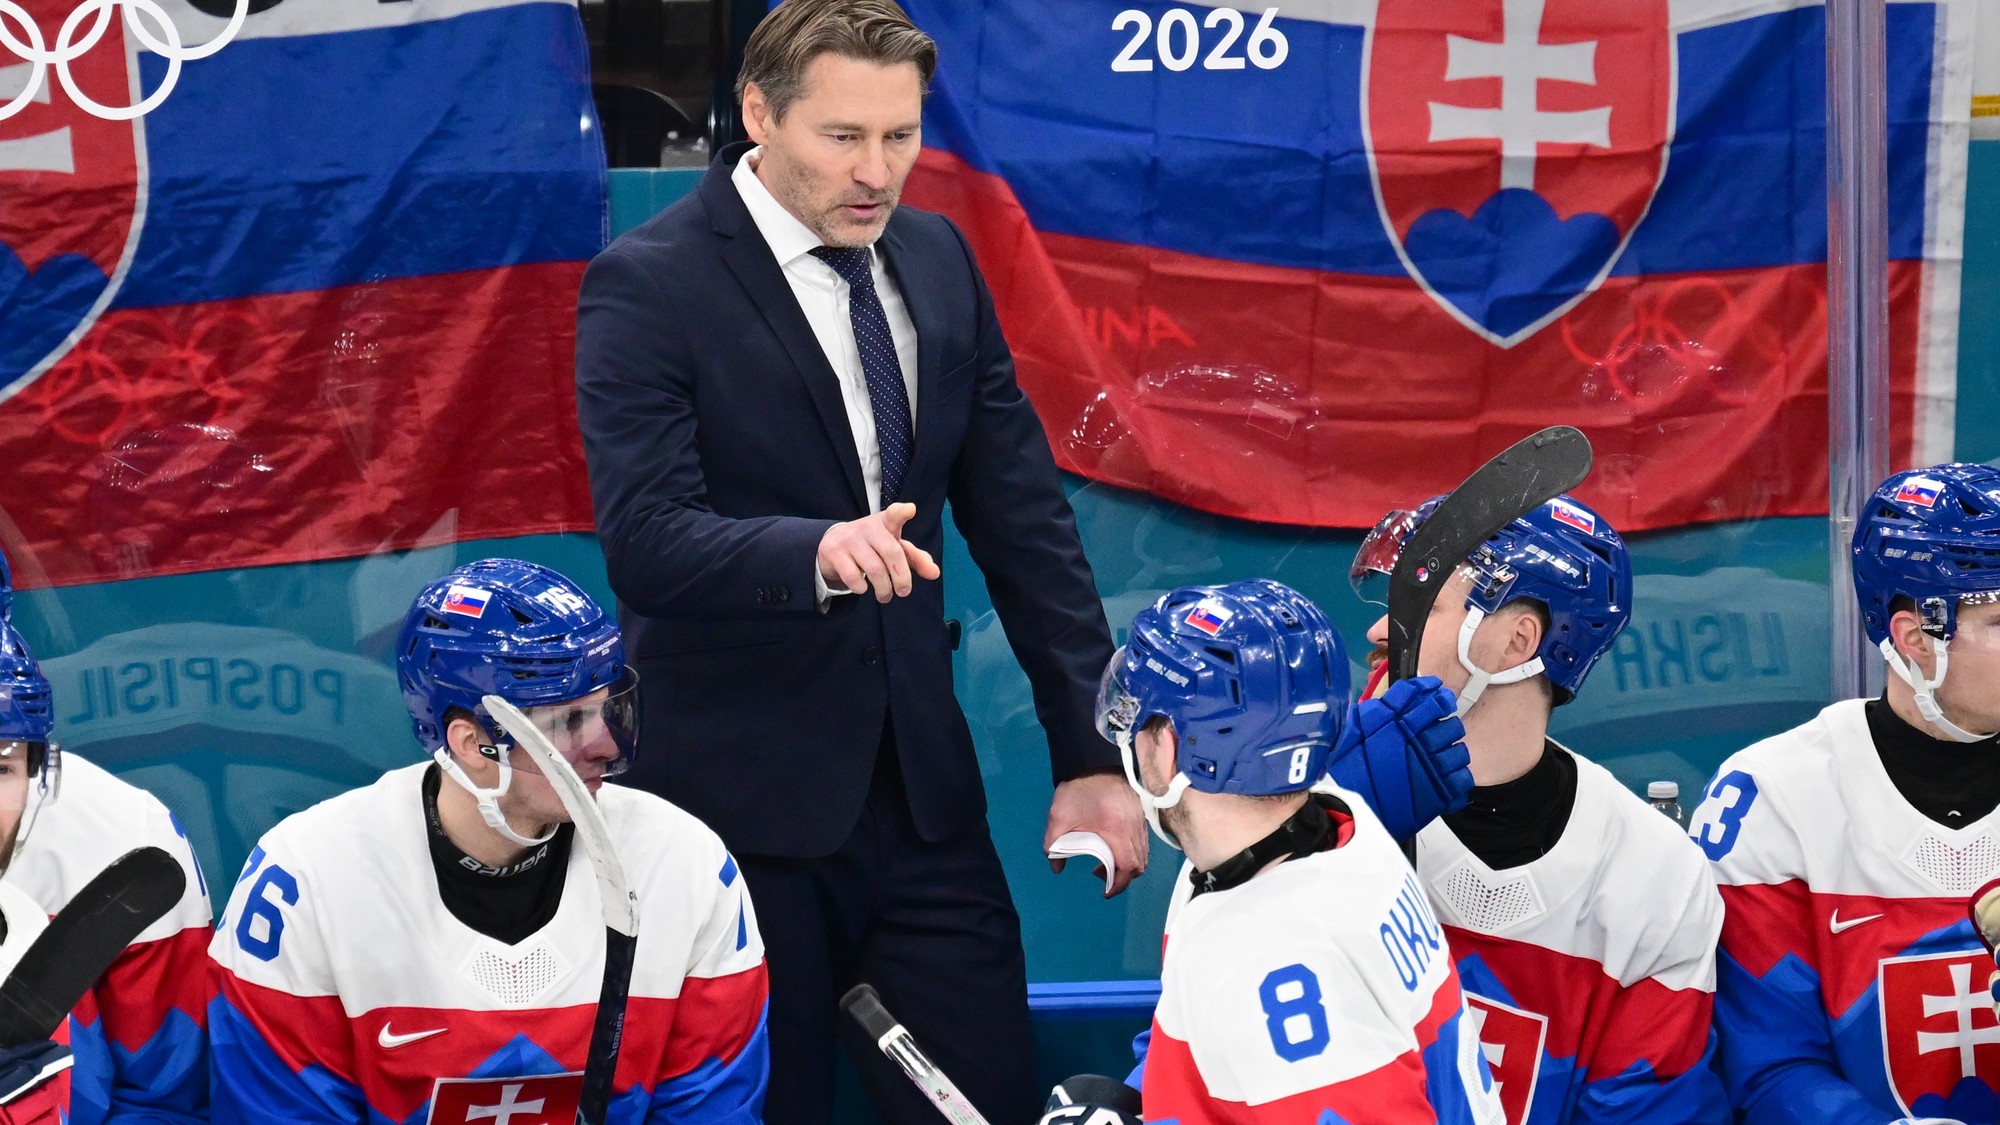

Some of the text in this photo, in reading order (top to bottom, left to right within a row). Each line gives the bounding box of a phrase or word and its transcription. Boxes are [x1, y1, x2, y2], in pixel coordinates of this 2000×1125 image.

[1111, 7, 1289, 72] 2026
[1524, 544, 1580, 578] BAUER
[535, 587, 583, 615] 76
[1288, 747, 1310, 784] 8
[1689, 768, 1759, 862] 3
[458, 843, 548, 878] BAUER
[1258, 963, 1331, 1063] 8
